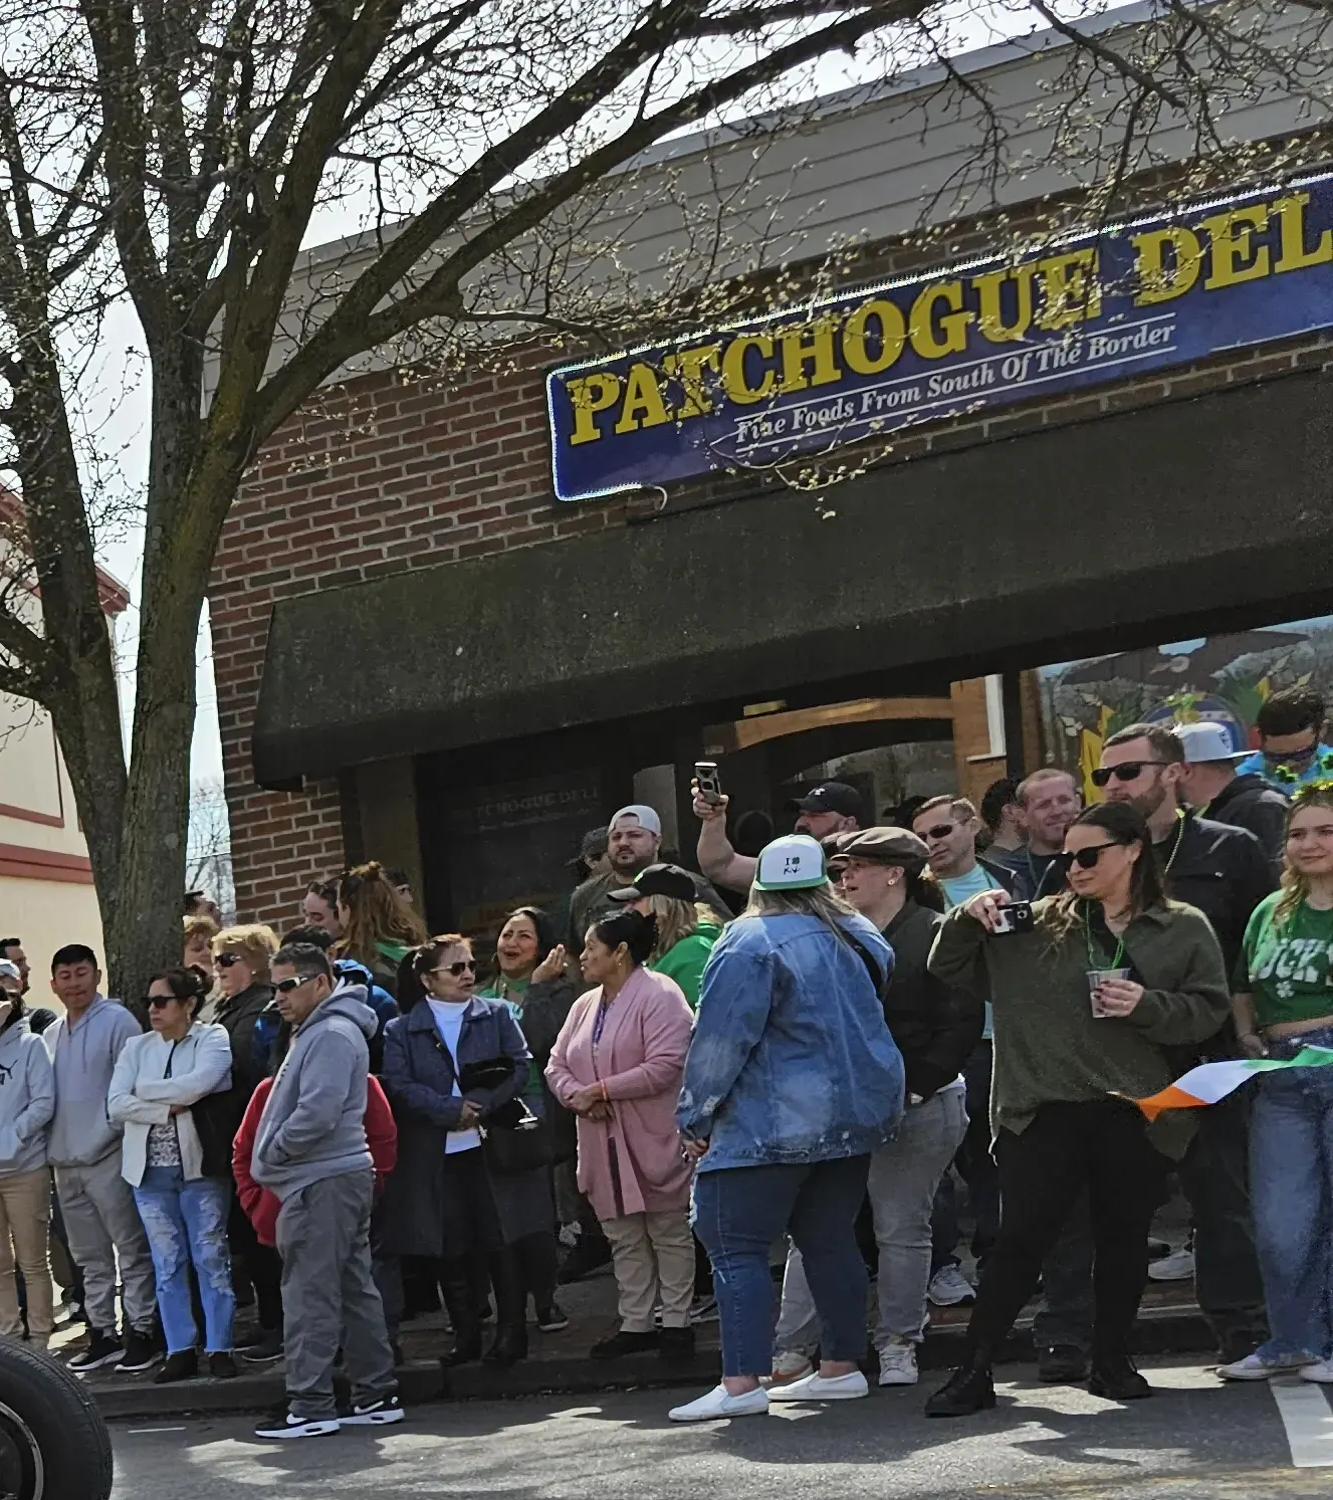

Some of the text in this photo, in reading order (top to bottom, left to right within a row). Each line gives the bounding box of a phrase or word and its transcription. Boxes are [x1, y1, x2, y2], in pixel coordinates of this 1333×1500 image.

[566, 193, 1333, 445] PATCHOGUE DEL
[736, 322, 1176, 443] Fine Foods From South Of The Border
